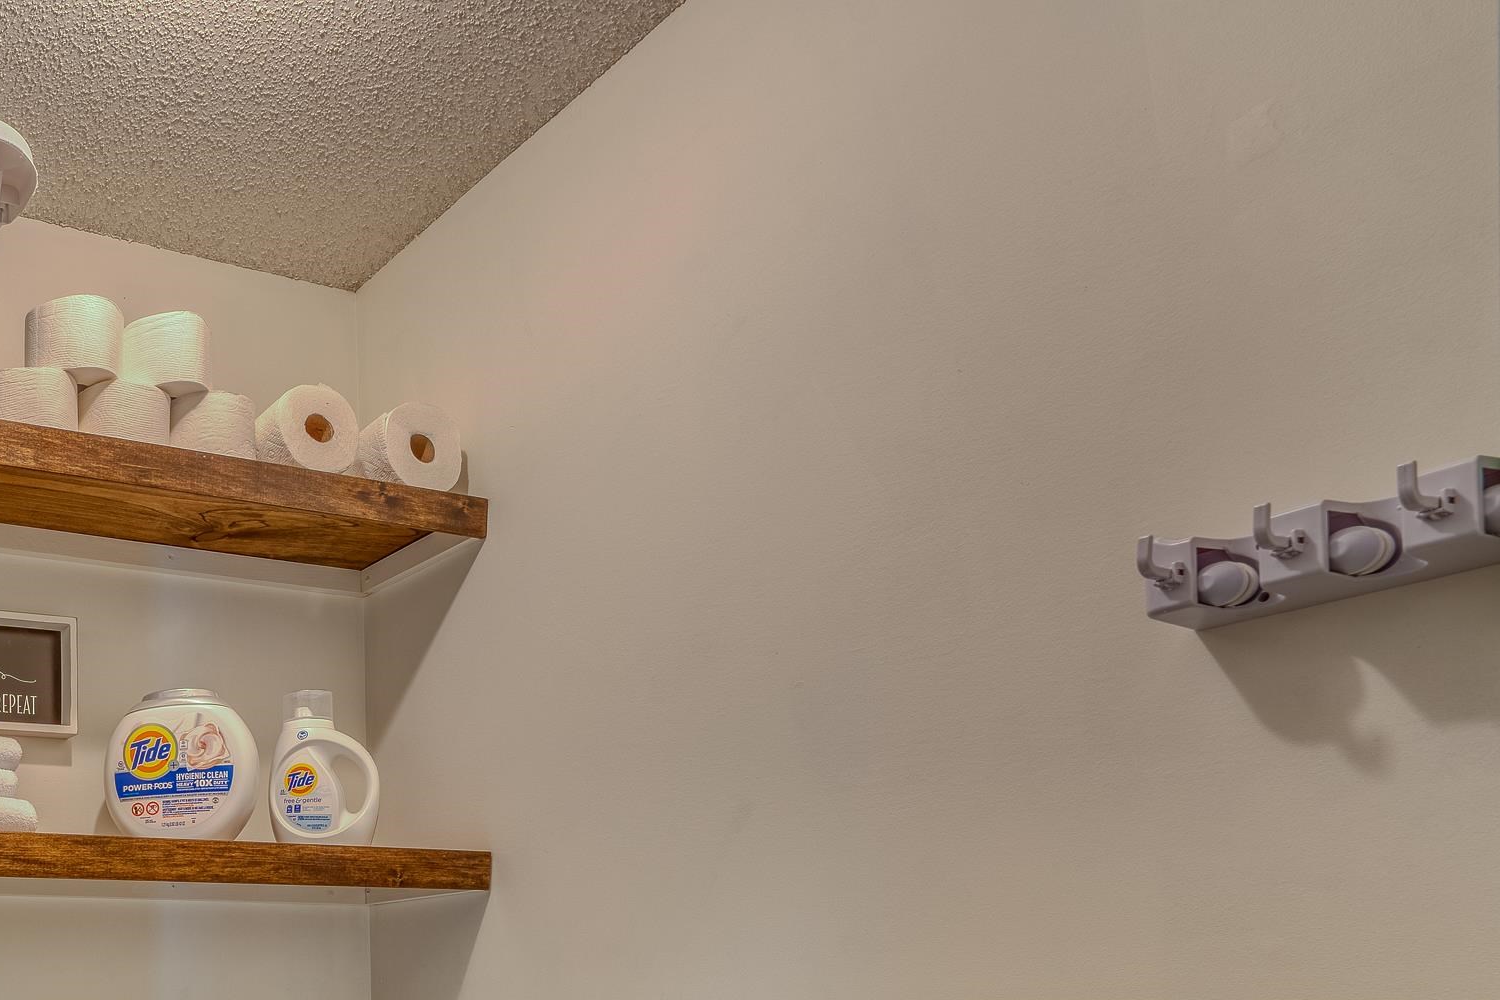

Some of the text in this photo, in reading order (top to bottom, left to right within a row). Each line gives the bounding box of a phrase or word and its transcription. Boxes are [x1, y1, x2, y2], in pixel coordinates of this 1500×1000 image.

[130, 737, 172, 771] Tide
[175, 770, 228, 780] HYGIENIC CLEAN
[193, 779, 213, 787] 10X
[288, 771, 315, 791] Tide
[122, 784, 153, 792] POWER
